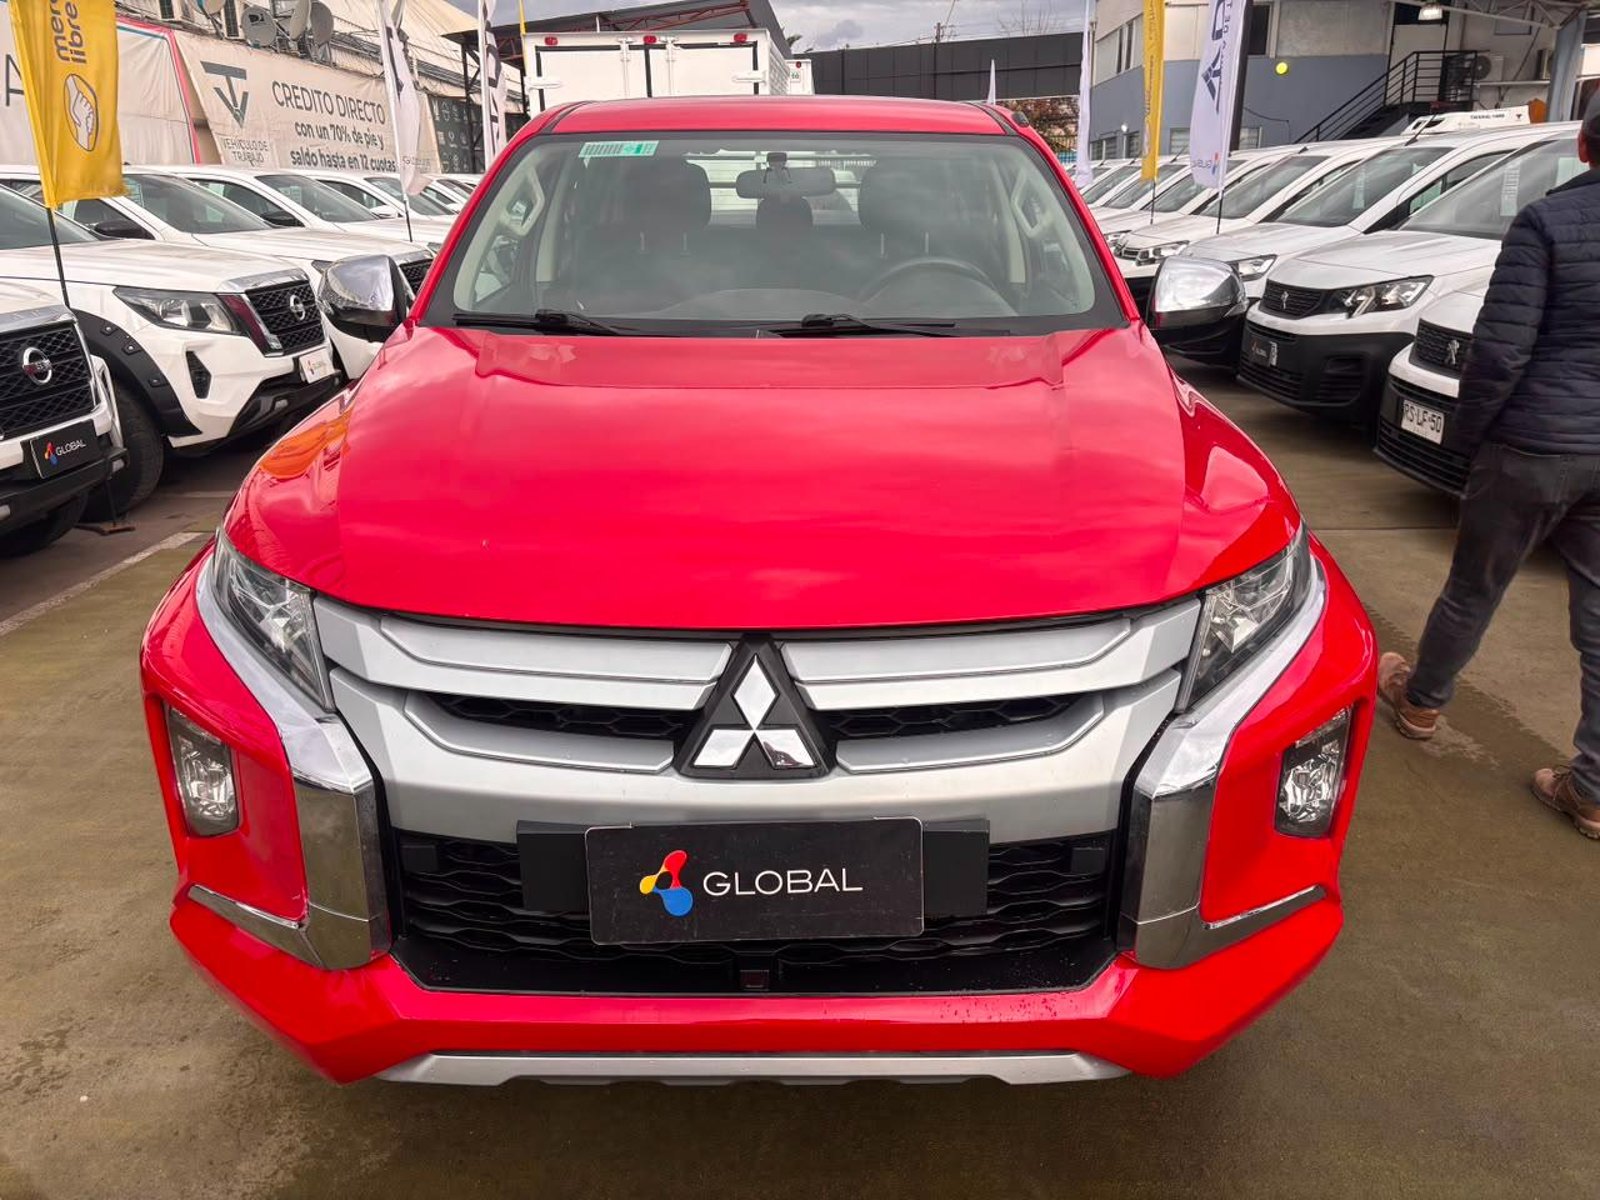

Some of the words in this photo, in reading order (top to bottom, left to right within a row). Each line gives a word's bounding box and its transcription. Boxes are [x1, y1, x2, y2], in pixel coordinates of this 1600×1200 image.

[49, 0, 70, 61] mer
[65, 1, 86, 64] libre
[271, 80, 335, 116] CREDITO
[335, 94, 386, 125] DIRECTO
[294, 121, 315, 137] con
[317, 124, 330, 141] un
[330, 123, 351, 143] 70%
[352, 127, 364, 145] de
[364, 128, 378, 149] pie
[378, 134, 385, 150] y
[290, 146, 318, 167] saldo
[318, 148, 347, 171] hasta
[347, 155, 359, 170] en
[360, 153, 370, 171] 12
[371, 155, 397, 173] cuotas
[55, 440, 87, 456] GLOBAL
[703, 868, 863, 896] GLOBAL
